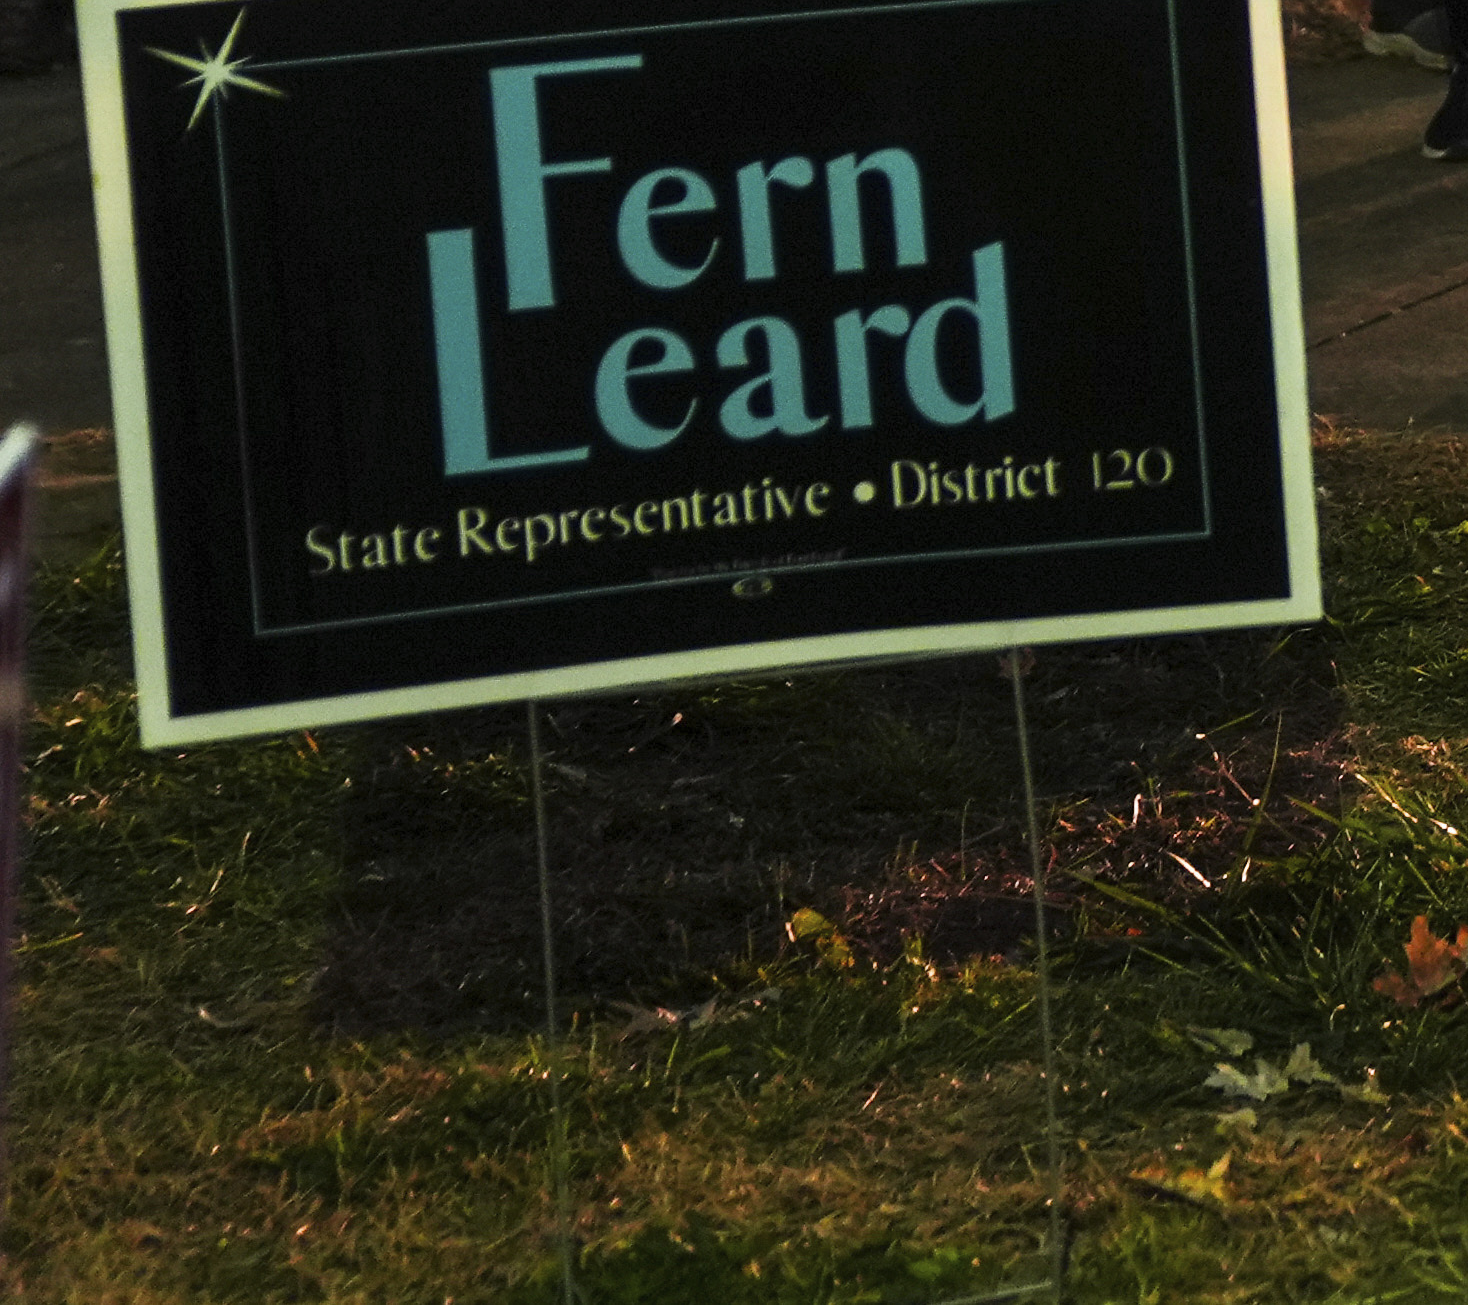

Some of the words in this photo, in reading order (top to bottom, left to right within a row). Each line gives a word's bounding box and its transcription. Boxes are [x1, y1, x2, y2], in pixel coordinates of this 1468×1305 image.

[489, 55, 928, 312] Fern
[425, 228, 1016, 475] Leard
[305, 525, 441, 575] State
[457, 477, 830, 561] Representative
[891, 456, 1060, 509] District
[1090, 447, 1175, 491] 120
